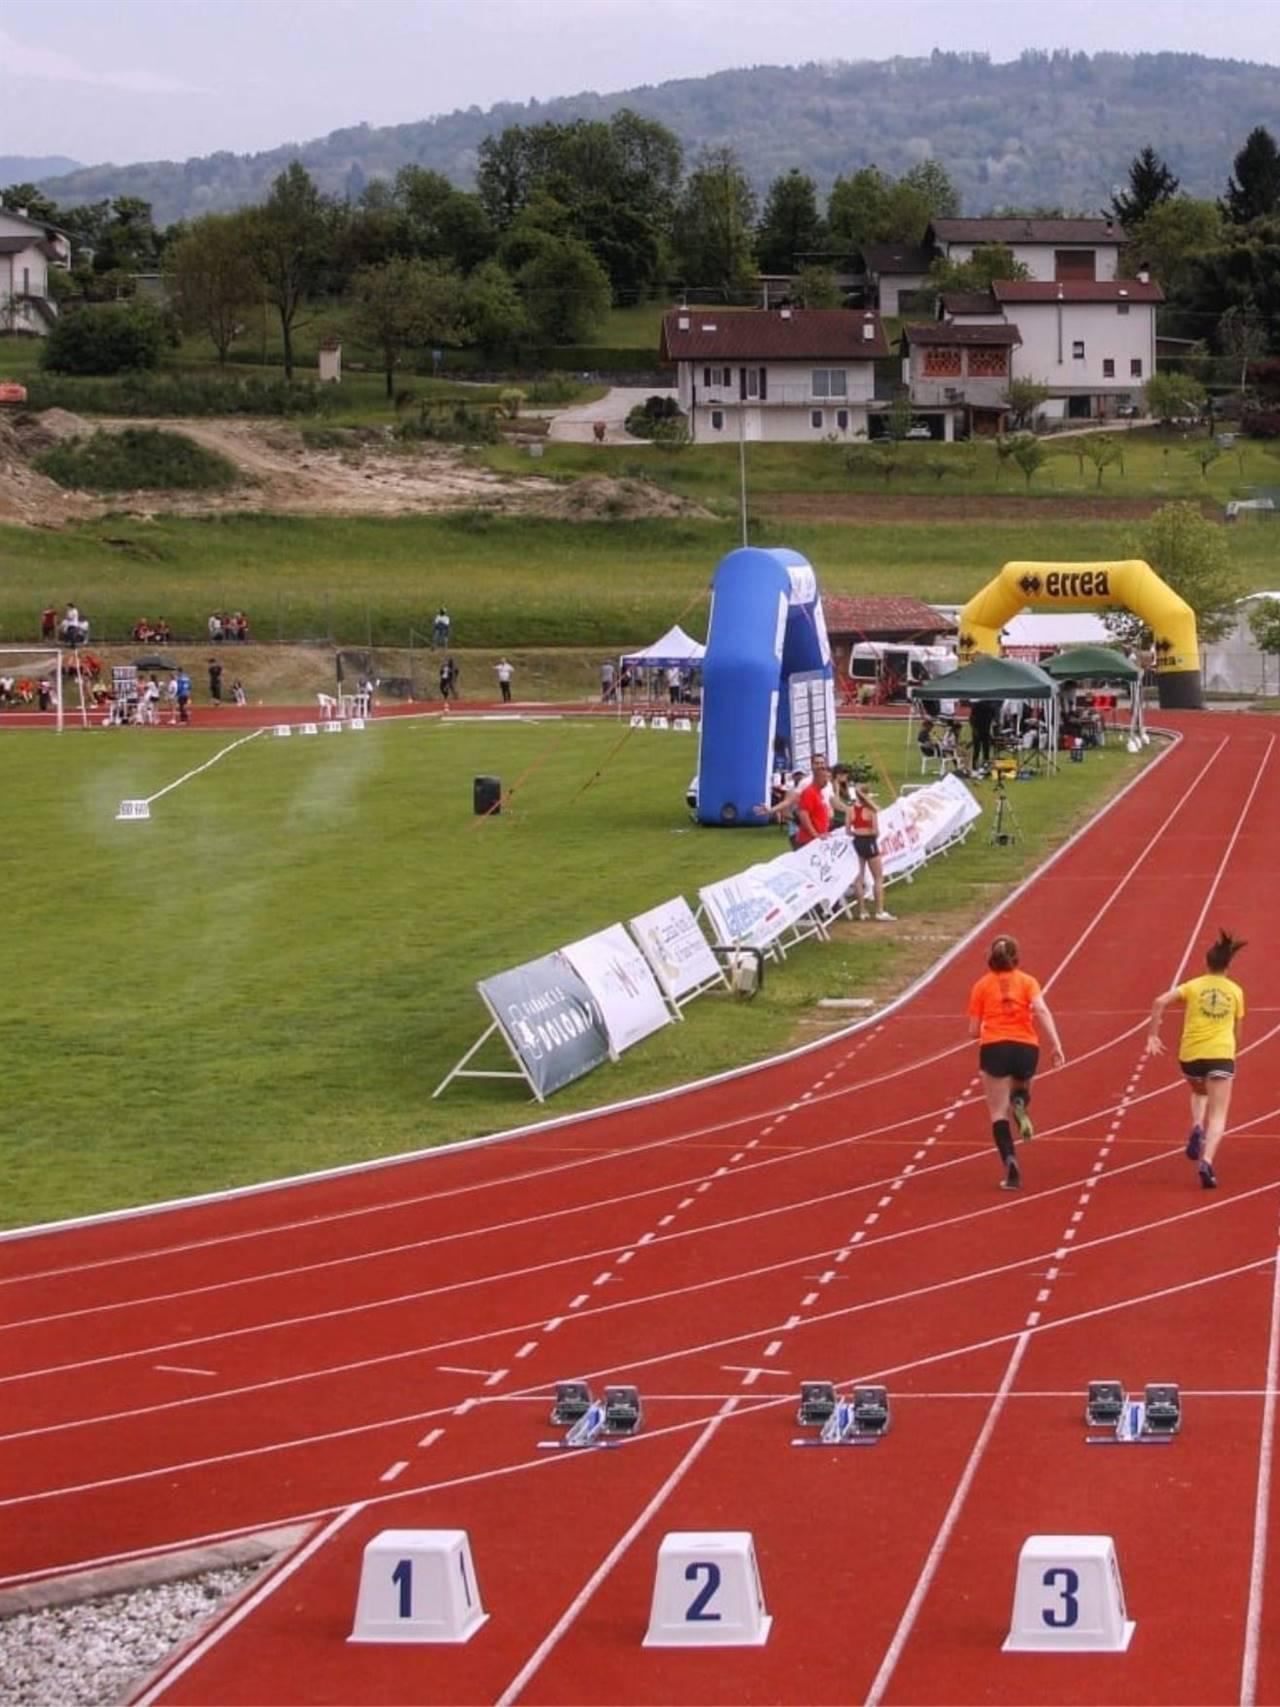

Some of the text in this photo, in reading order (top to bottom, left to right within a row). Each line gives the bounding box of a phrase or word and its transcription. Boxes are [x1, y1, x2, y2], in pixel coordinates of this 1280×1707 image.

[1046, 571, 1109, 597] errea
[391, 1559, 412, 1618] 1
[685, 1561, 722, 1621] 2
[1042, 1567, 1079, 1628] 3
